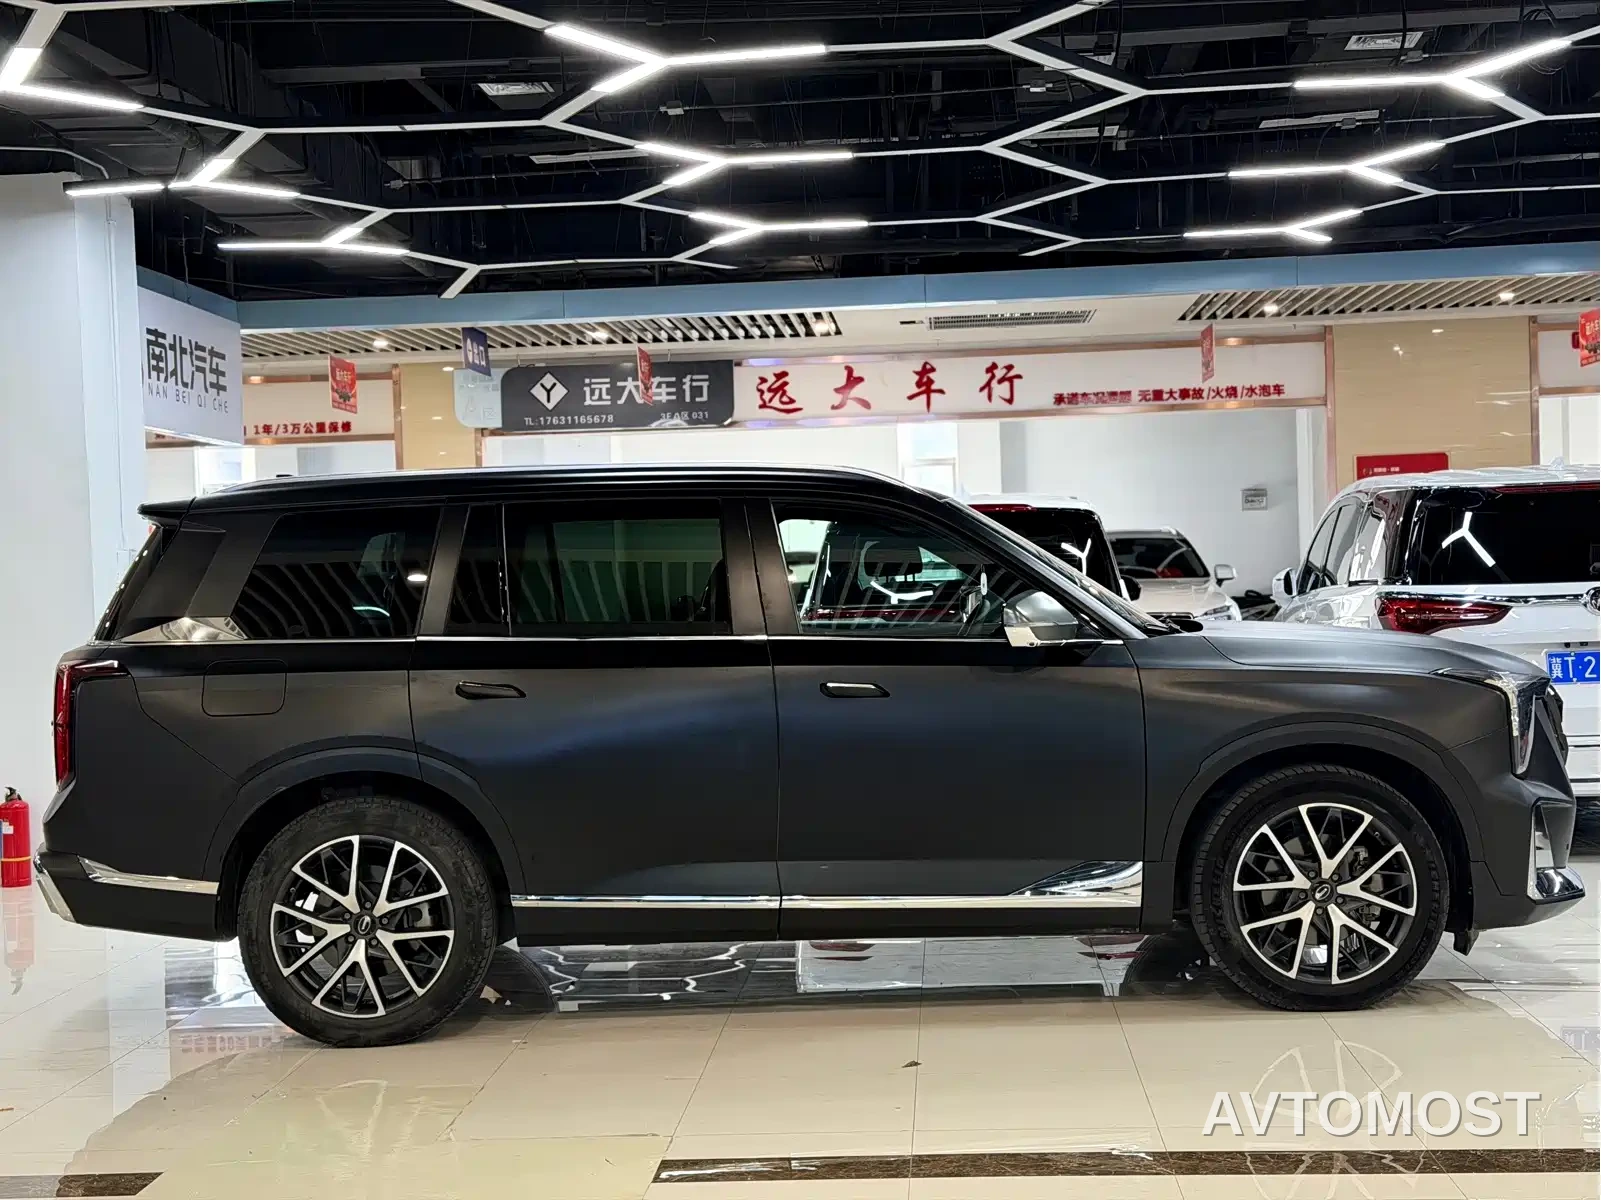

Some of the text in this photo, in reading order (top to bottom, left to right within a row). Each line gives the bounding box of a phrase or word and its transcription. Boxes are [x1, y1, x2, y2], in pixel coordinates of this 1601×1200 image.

[146, 327, 227, 396] 南北汽车
[148, 382, 168, 399] NAN
[175, 388, 190, 406] BEI
[212, 398, 228, 414] CHE
[583, 375, 710, 406] 远大车行
[756, 361, 1023, 413] 远大车行
